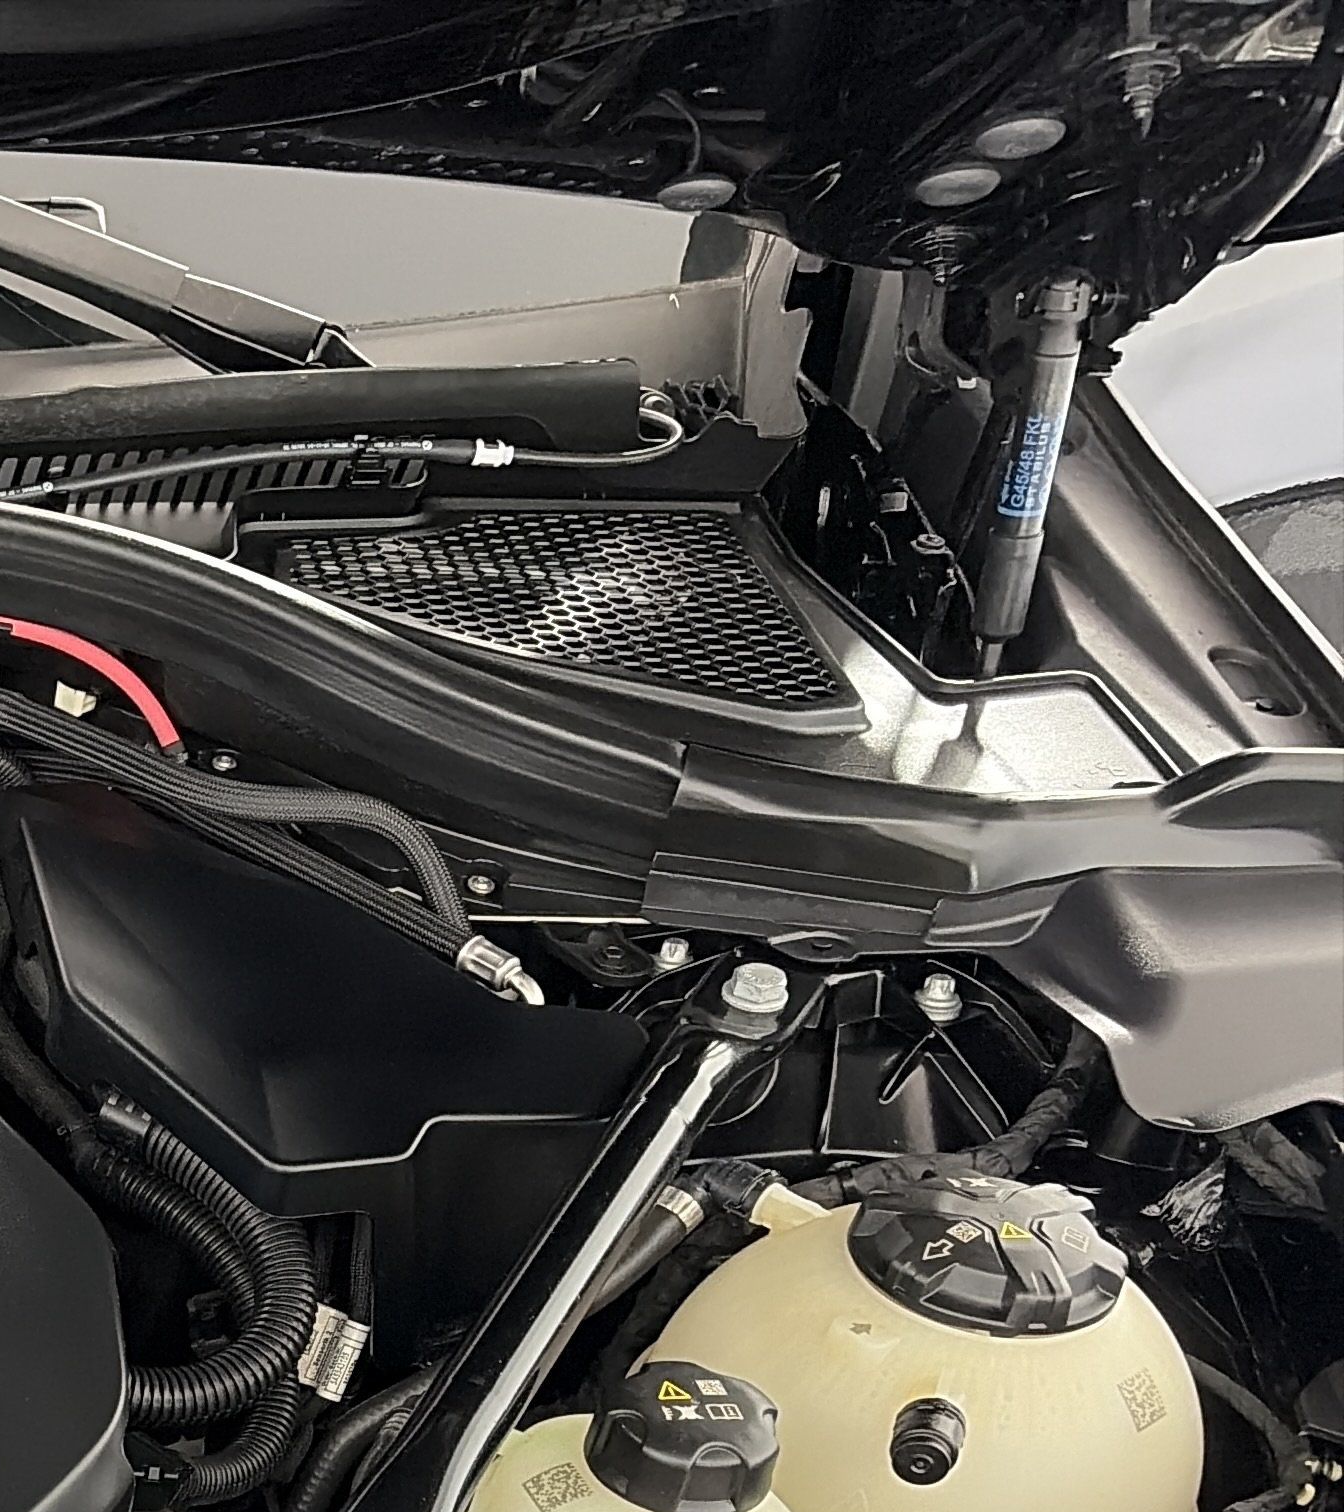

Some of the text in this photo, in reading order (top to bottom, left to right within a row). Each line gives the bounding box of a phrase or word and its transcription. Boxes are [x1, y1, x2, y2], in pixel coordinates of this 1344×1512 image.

[1009, 413, 1043, 508] G45/48 FKL
[1024, 421, 1051, 509] STABILUS
